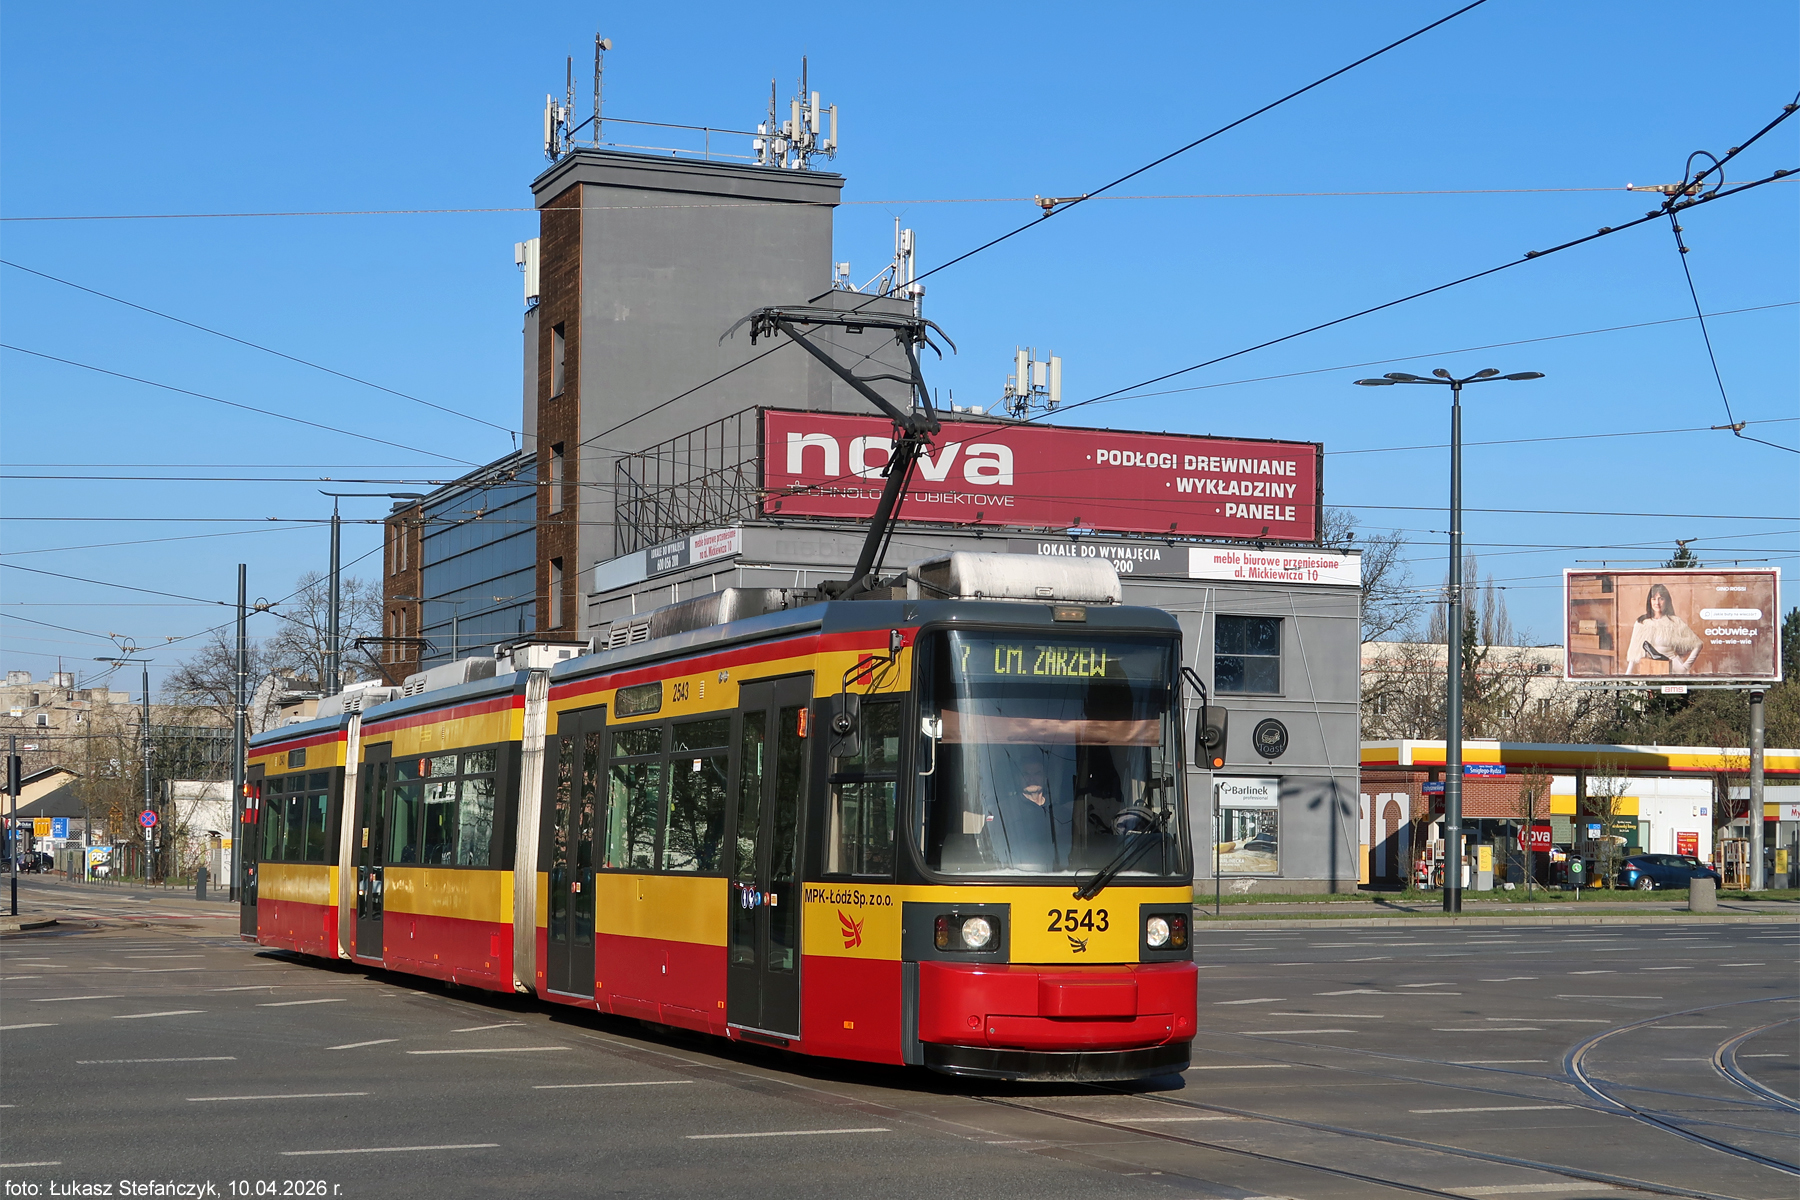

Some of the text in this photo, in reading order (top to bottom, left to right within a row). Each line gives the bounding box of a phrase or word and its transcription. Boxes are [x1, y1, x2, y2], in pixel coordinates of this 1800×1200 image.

[787, 432, 1014, 486] nova
[1096, 449, 1297, 476] PODŁOGI DREWNIANE
[1176, 477, 1297, 498] WYKŁADZINY
[1225, 502, 1296, 521] PANELE
[1037, 543, 1161, 562] LOKALE DO WYNAJĘCIA
[1213, 552, 1339, 570] meble biurowe przeniesione
[1113, 559, 1133, 573] 200
[1234, 566, 1318, 581] al. Mickiewicza 10
[1704, 626, 1758, 637] eobuwie.pl
[1033, 646, 1107, 677] ZARZEW
[672, 682, 689, 702] 2543
[1259, 743, 1284, 753] Toast
[1232, 785, 1268, 795] Barlinek
[804, 888, 894, 908] MPK-Łódź Sp. z o.o.
[1047, 908, 1110, 932] 2543
